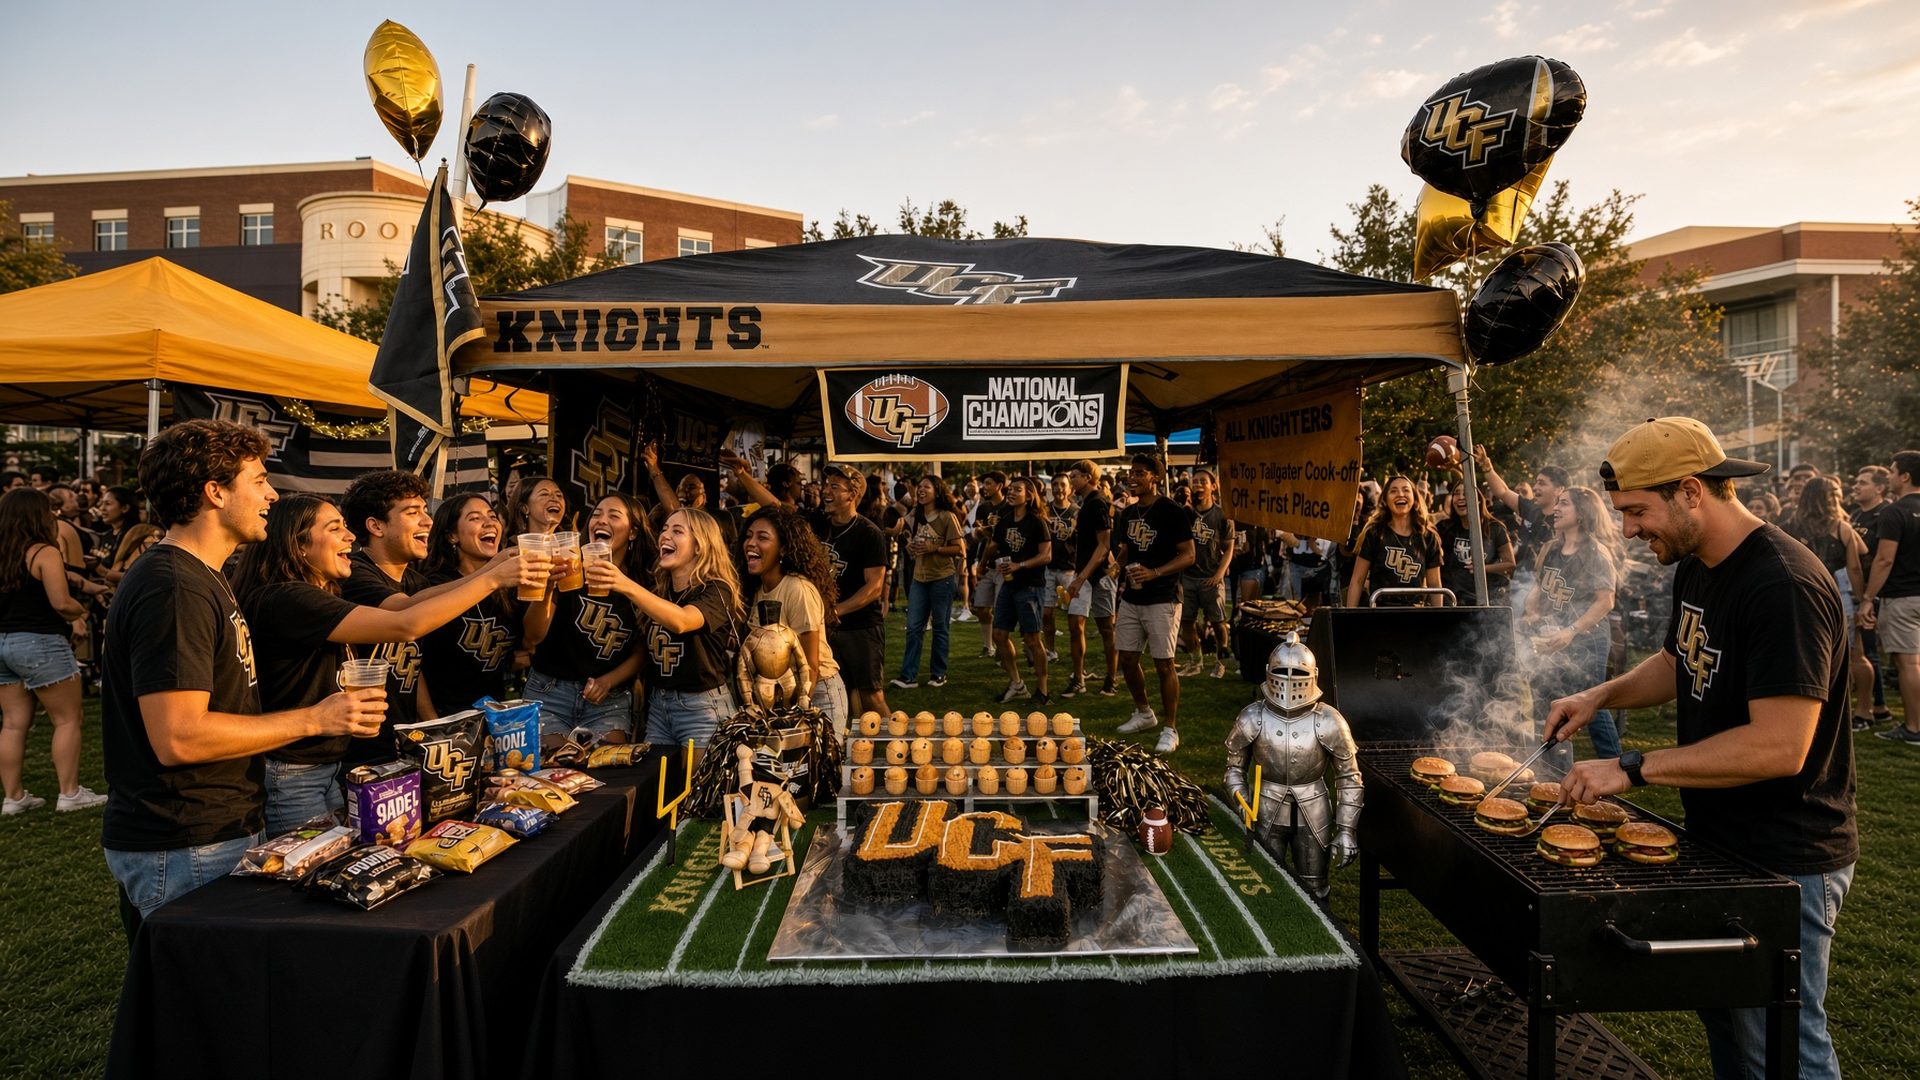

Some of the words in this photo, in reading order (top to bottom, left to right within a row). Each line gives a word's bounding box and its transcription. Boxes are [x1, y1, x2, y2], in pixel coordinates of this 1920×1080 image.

[1422, 91, 1513, 166] UCF
[320, 221, 416, 240] ROO
[862, 256, 1073, 304] UCF
[493, 306, 761, 352] KNIGHTS
[988, 376, 1078, 400] NATIONAL
[867, 395, 930, 447] UCF
[968, 400, 1098, 428] CHAMPIONS
[1225, 420, 1245, 442] ALL
[1248, 404, 1332, 440] KNIGHTERS
[1240, 462, 1256, 484] Top
[1305, 460, 1358, 482] Cook-off
[1231, 487, 1249, 509] Off
[1258, 489, 1288, 514] First
[1292, 493, 1329, 519] Place
[1128, 520, 1156, 551] UCF
[1386, 547, 1421, 582] UCF
[1542, 567, 1574, 611] UCF
[577, 597, 630, 659] UCF
[1678, 603, 1720, 699] UCF
[423, 741, 475, 789] UCF
[856, 800, 1093, 898] UCF
